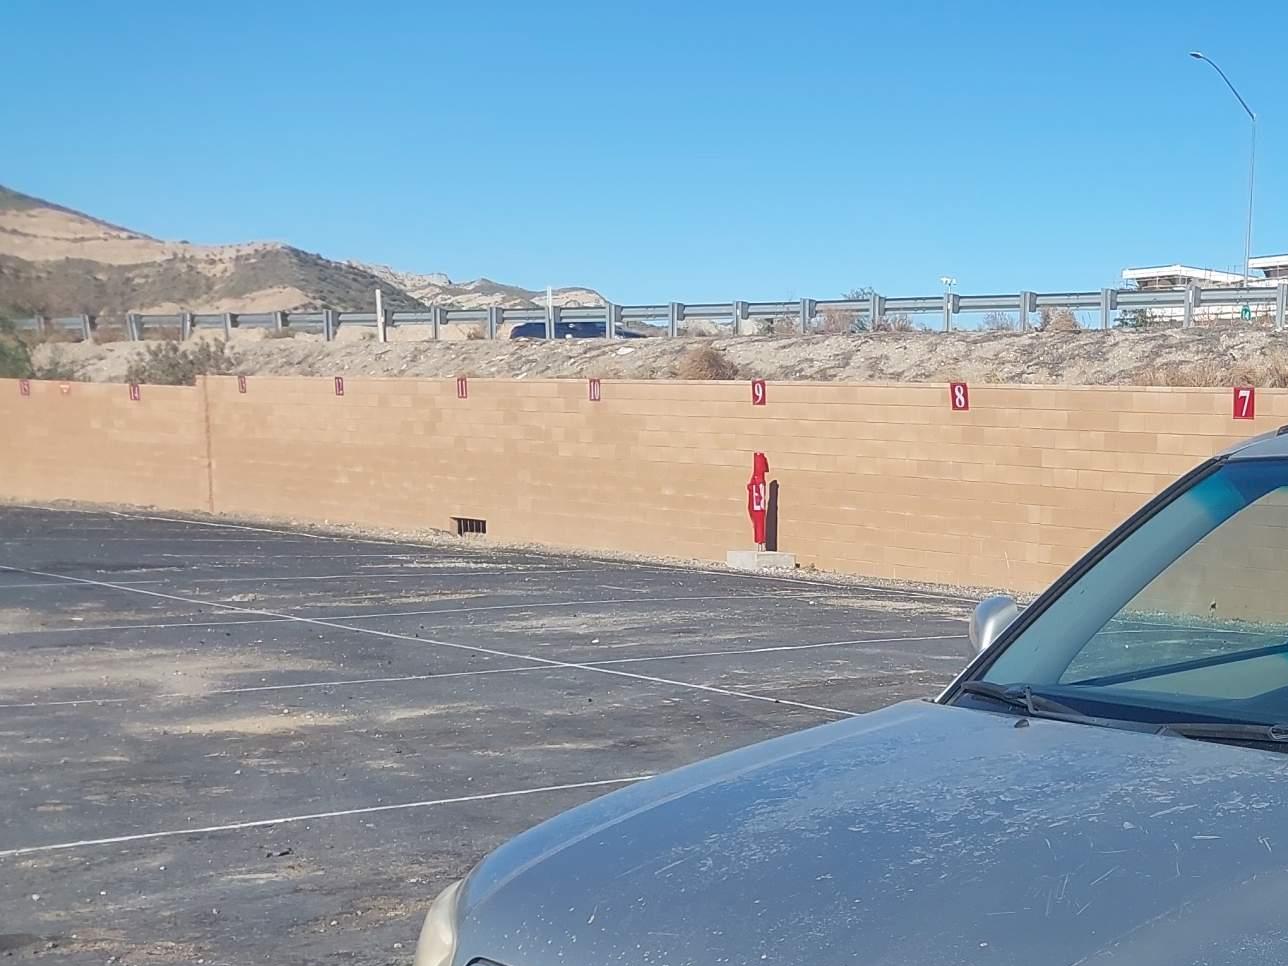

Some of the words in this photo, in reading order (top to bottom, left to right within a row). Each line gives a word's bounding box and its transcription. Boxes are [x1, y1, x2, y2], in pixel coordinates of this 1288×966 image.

[458, 379, 467, 397] 11
[590, 380, 600, 400] 10
[754, 382, 763, 404] 9
[954, 385, 966, 408] 8
[1238, 389, 1251, 417] 7
